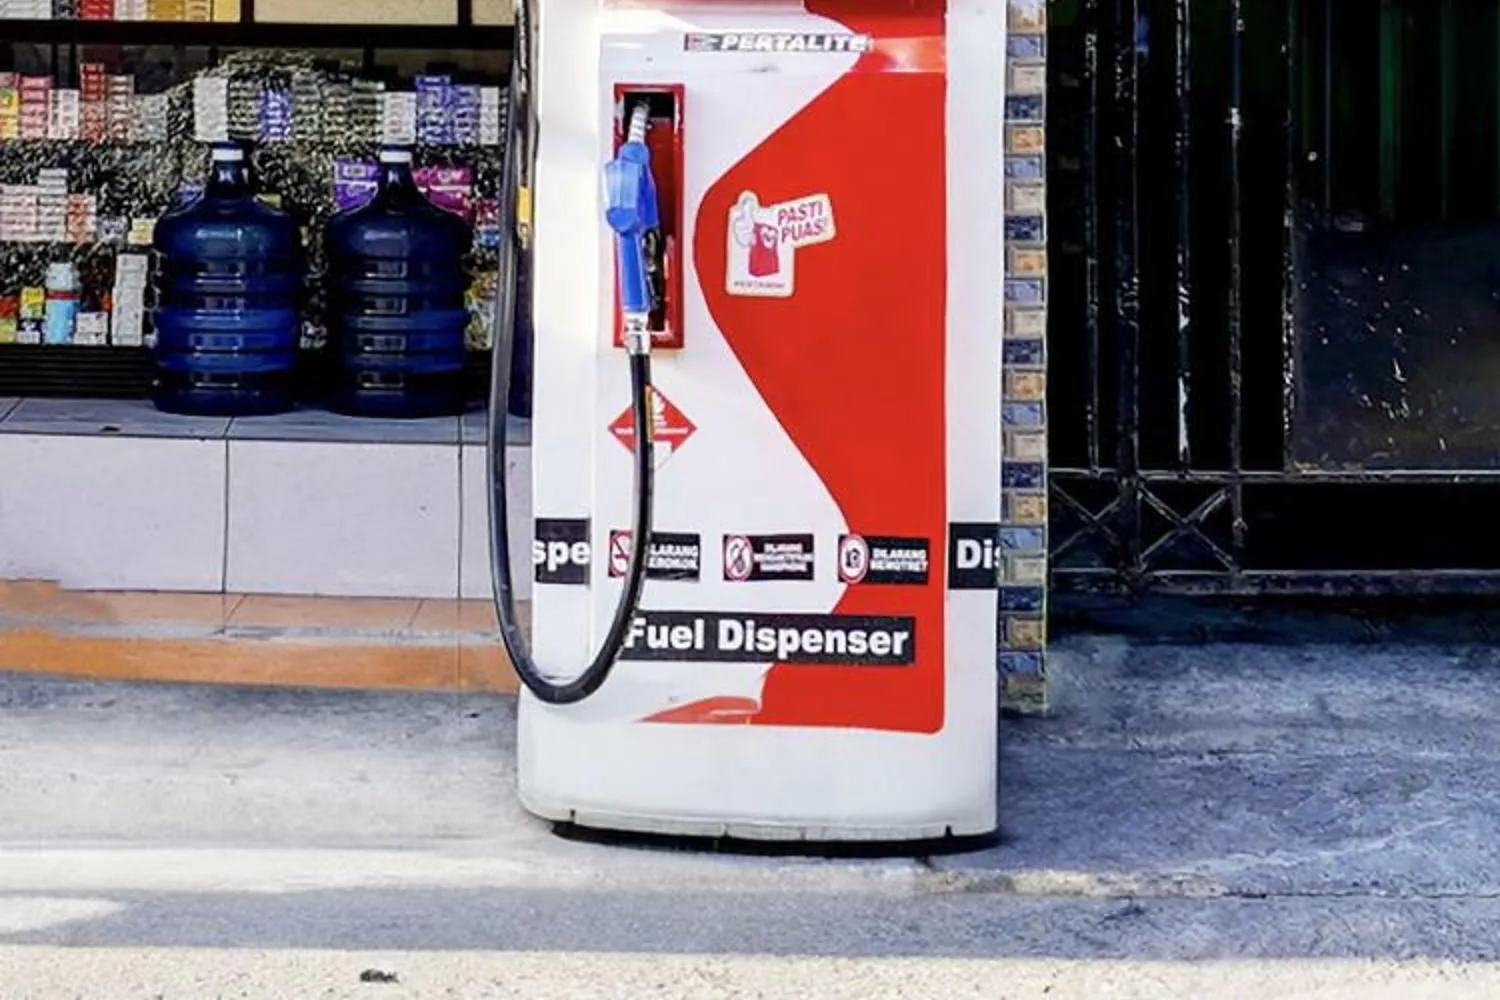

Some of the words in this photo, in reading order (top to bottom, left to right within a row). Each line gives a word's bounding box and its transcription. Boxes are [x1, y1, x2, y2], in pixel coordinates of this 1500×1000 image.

[720, 32, 869, 51] PERTALITE
[778, 200, 824, 225] PASTI
[624, 617, 704, 651] Fuel
[717, 618, 909, 660] Dispenser
